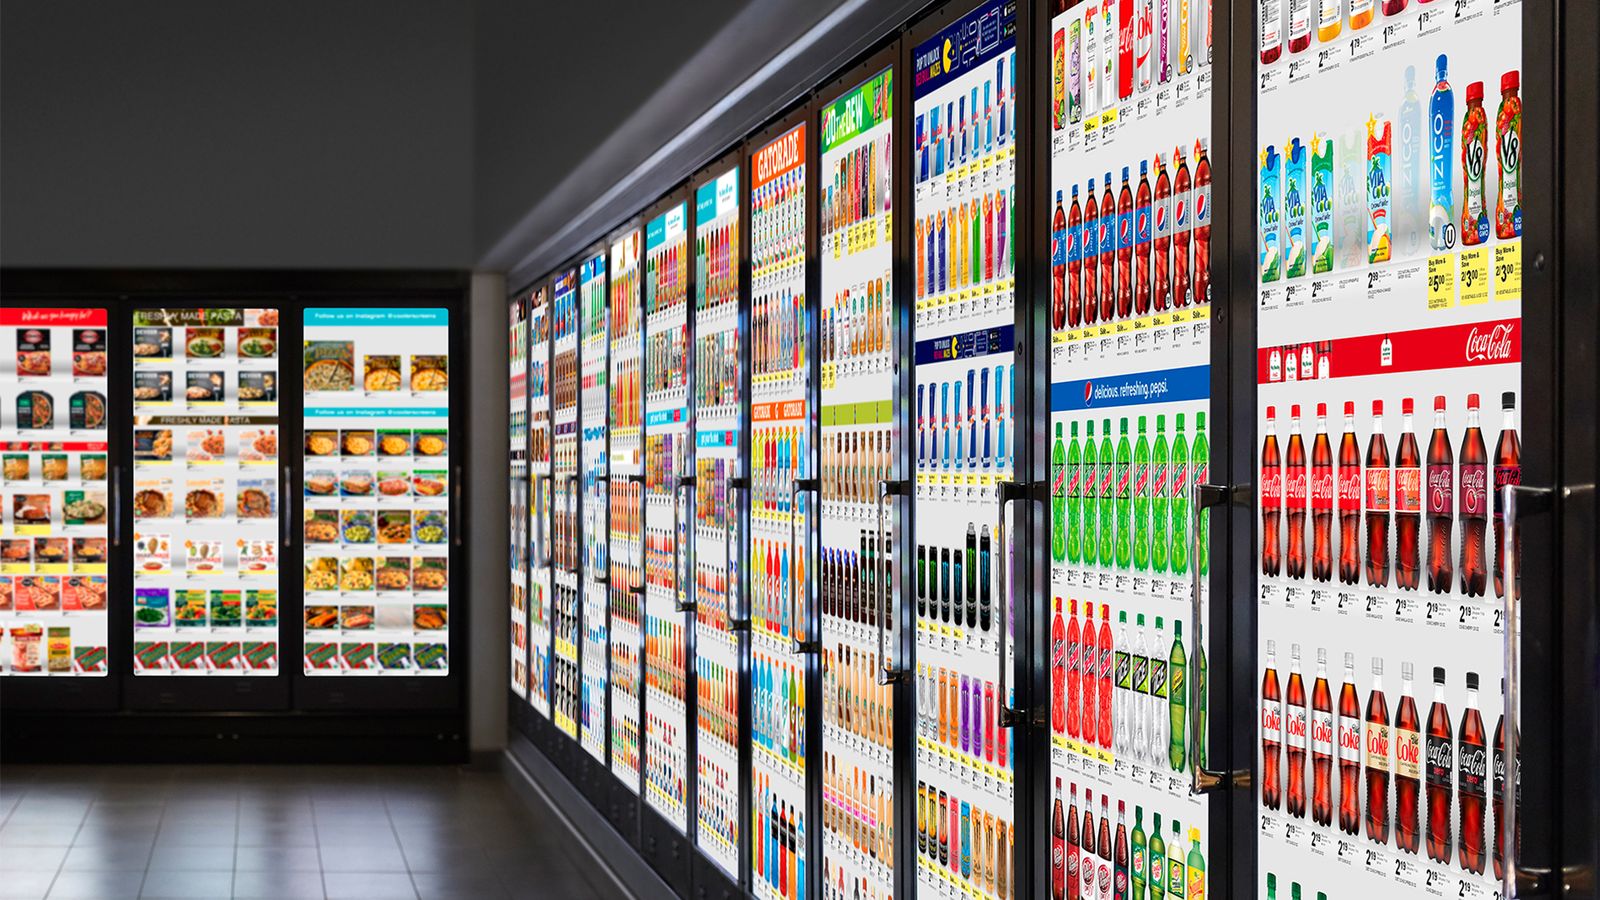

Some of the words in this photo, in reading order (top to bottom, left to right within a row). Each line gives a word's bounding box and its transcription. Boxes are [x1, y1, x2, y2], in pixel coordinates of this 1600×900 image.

[846, 92, 864, 134] DEW
[757, 130, 799, 182] GATORADE
[1434, 114, 1444, 180] ZICO
[1467, 136, 1482, 177] V8
[1502, 126, 1518, 169] V8
[210, 311, 242, 319] PASTA
[1466, 323, 1514, 361] Coca-Cola
[1094, 384, 1119, 399] delicious.
[1150, 378, 1168, 398] pepsi.
[1262, 708, 1280, 731] Coke
[1286, 714, 1305, 737] Coke
[1312, 719, 1332, 743] Coke
[1338, 725, 1359, 750] Coke
[1367, 729, 1388, 757] Coke
[1396, 736, 1419, 764] Coke
